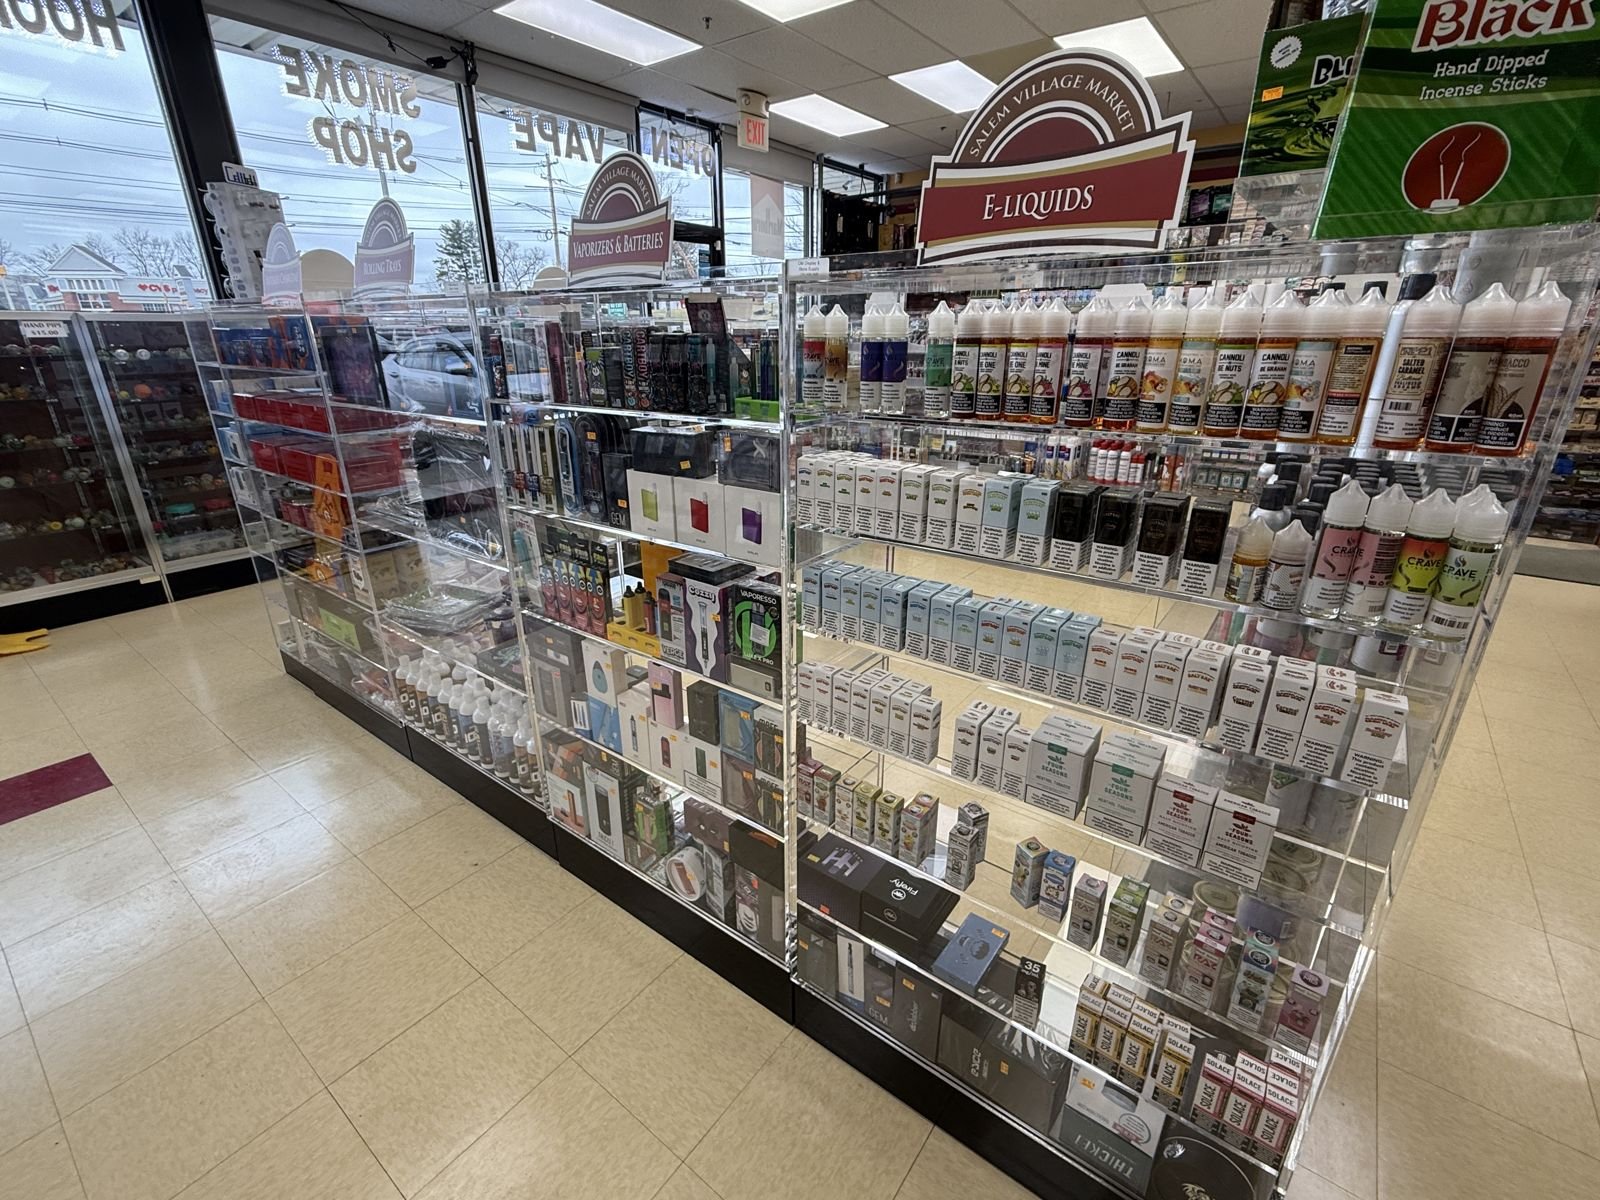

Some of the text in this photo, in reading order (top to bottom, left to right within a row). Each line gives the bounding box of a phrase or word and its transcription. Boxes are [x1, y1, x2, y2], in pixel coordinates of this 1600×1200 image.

[1416, 0, 1592, 50] Black
[1433, 50, 1551, 79] Hand Dipped
[1419, 74, 1549, 101] Incense Sticks
[969, 74, 1136, 158] SALEM VILLAGE MARKET
[746, 118, 766, 146] EXIT
[586, 165, 652, 216] SALEM VILLAGE MARKET
[983, 184, 1095, 221] E-LIQUIDS
[573, 231, 664, 259] VAPORIZERS & BATTERIES
[1117, 351, 1140, 359] CANNOLI
[1407, 557, 1442, 568] CRAVE
[1442, 564, 1477, 578] CRAVE
[741, 590, 777, 604] VAPORESSO
[1225, 832, 1253, 845] SEASONS
[889, 878, 919, 896] Firefly
[1024, 960, 1041, 973] 35
[1107, 1005, 1128, 1020] SOLACE
[1135, 1005, 1158, 1019] SOLACE
[1076, 1015, 1088, 1040] SOLACE
[1132, 1020, 1154, 1035] SOLACE
[1167, 1020, 1189, 1033] SOLACE
[1101, 1027, 1114, 1052] SOLACE
[1168, 1038, 1192, 1053] SOLACE
[1126, 1043, 1139, 1069] SOLACE
[1161, 1062, 1176, 1088] SOLACE
[1207, 1058, 1232, 1075] SOLACE
[1241, 1059, 1265, 1075] SOLACE
[1237, 1073, 1261, 1090] SOLACE
[1272, 1073, 1297, 1089] SOLACE
[1200, 1083, 1216, 1109] SOLACE
[1268, 1089, 1294, 1106] SOLACE
[1230, 1100, 1247, 1126] SOLACE
[1261, 1115, 1279, 1142] SOLACE
[1074, 1134, 1135, 1179] THICKET
